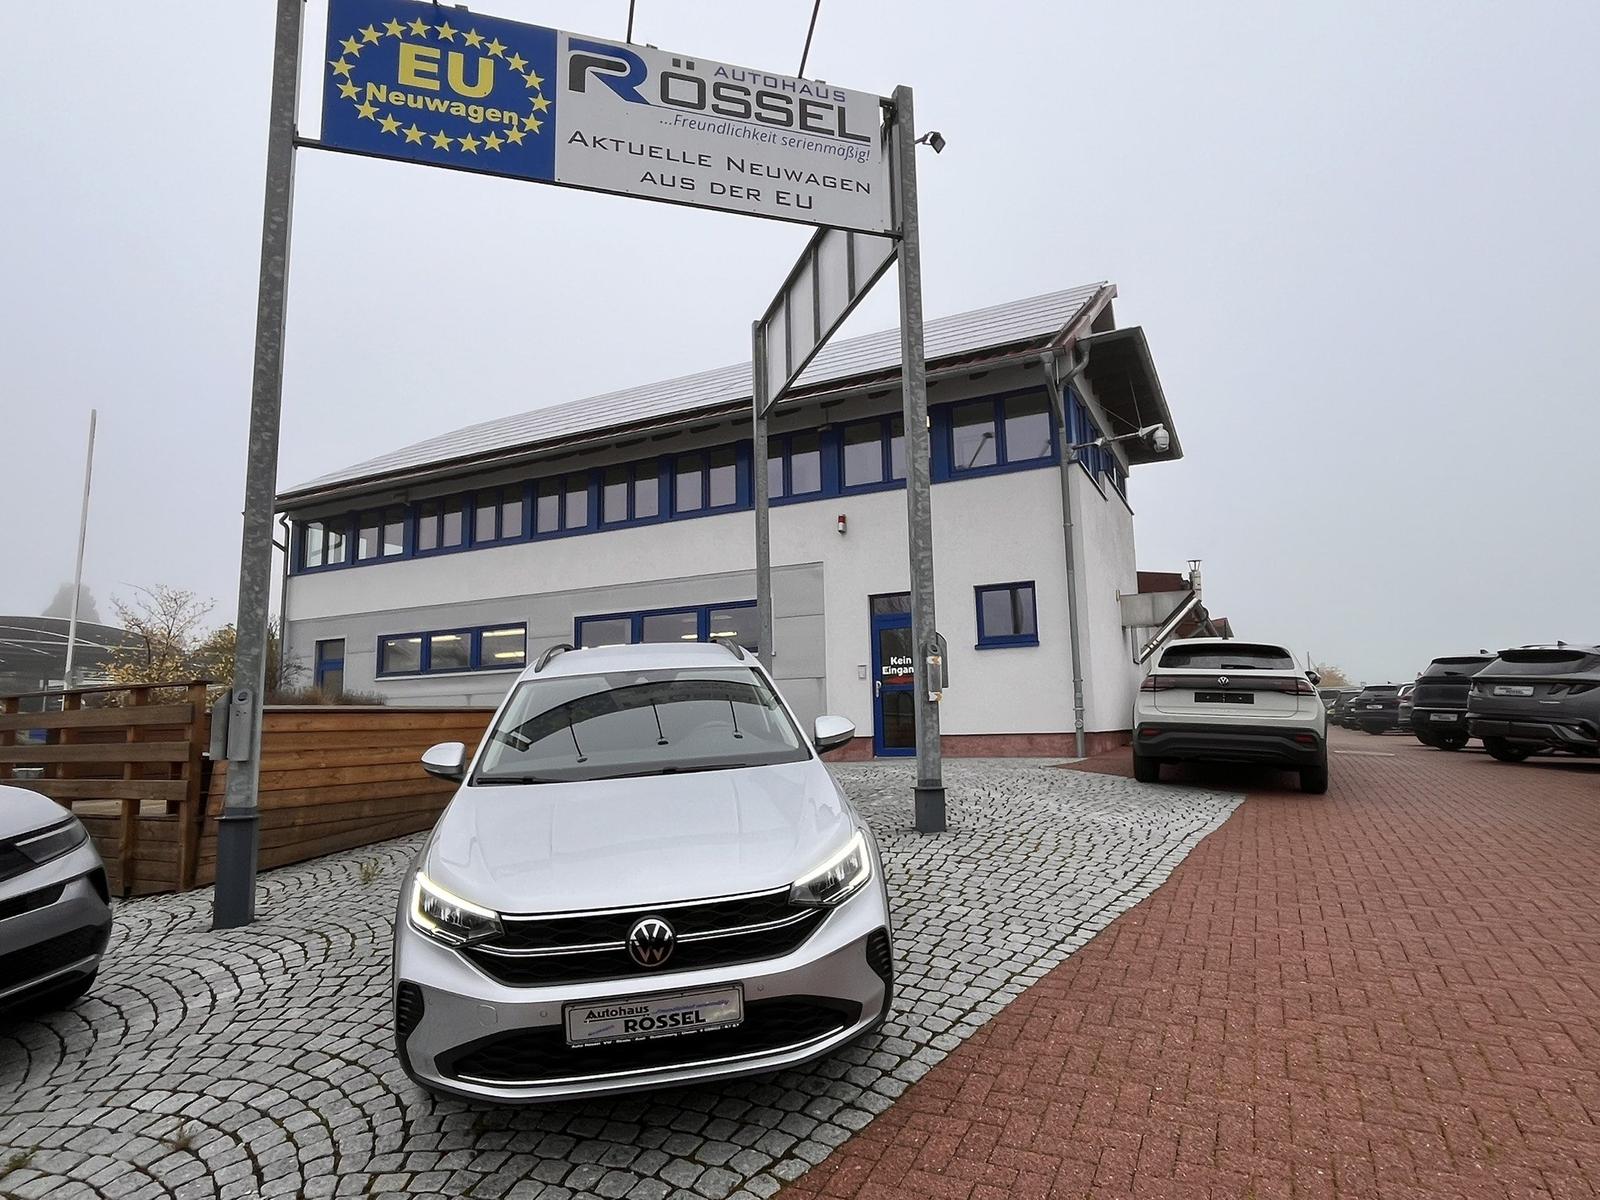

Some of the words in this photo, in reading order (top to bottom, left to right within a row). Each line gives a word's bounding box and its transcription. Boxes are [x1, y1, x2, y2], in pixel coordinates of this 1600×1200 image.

[398, 42, 494, 98] EU
[714, 66, 846, 102] AUTOHAUS
[366, 82, 519, 126] Neuwagen
[781, 136, 870, 163] serienmäßig!
[640, 171, 695, 191] AUS
[710, 182, 761, 202] DER
[776, 190, 813, 209] EU
[882, 666, 915, 677] Eingan
[890, 656, 912, 665] Kein
[585, 1006, 649, 1020] Autohaus
